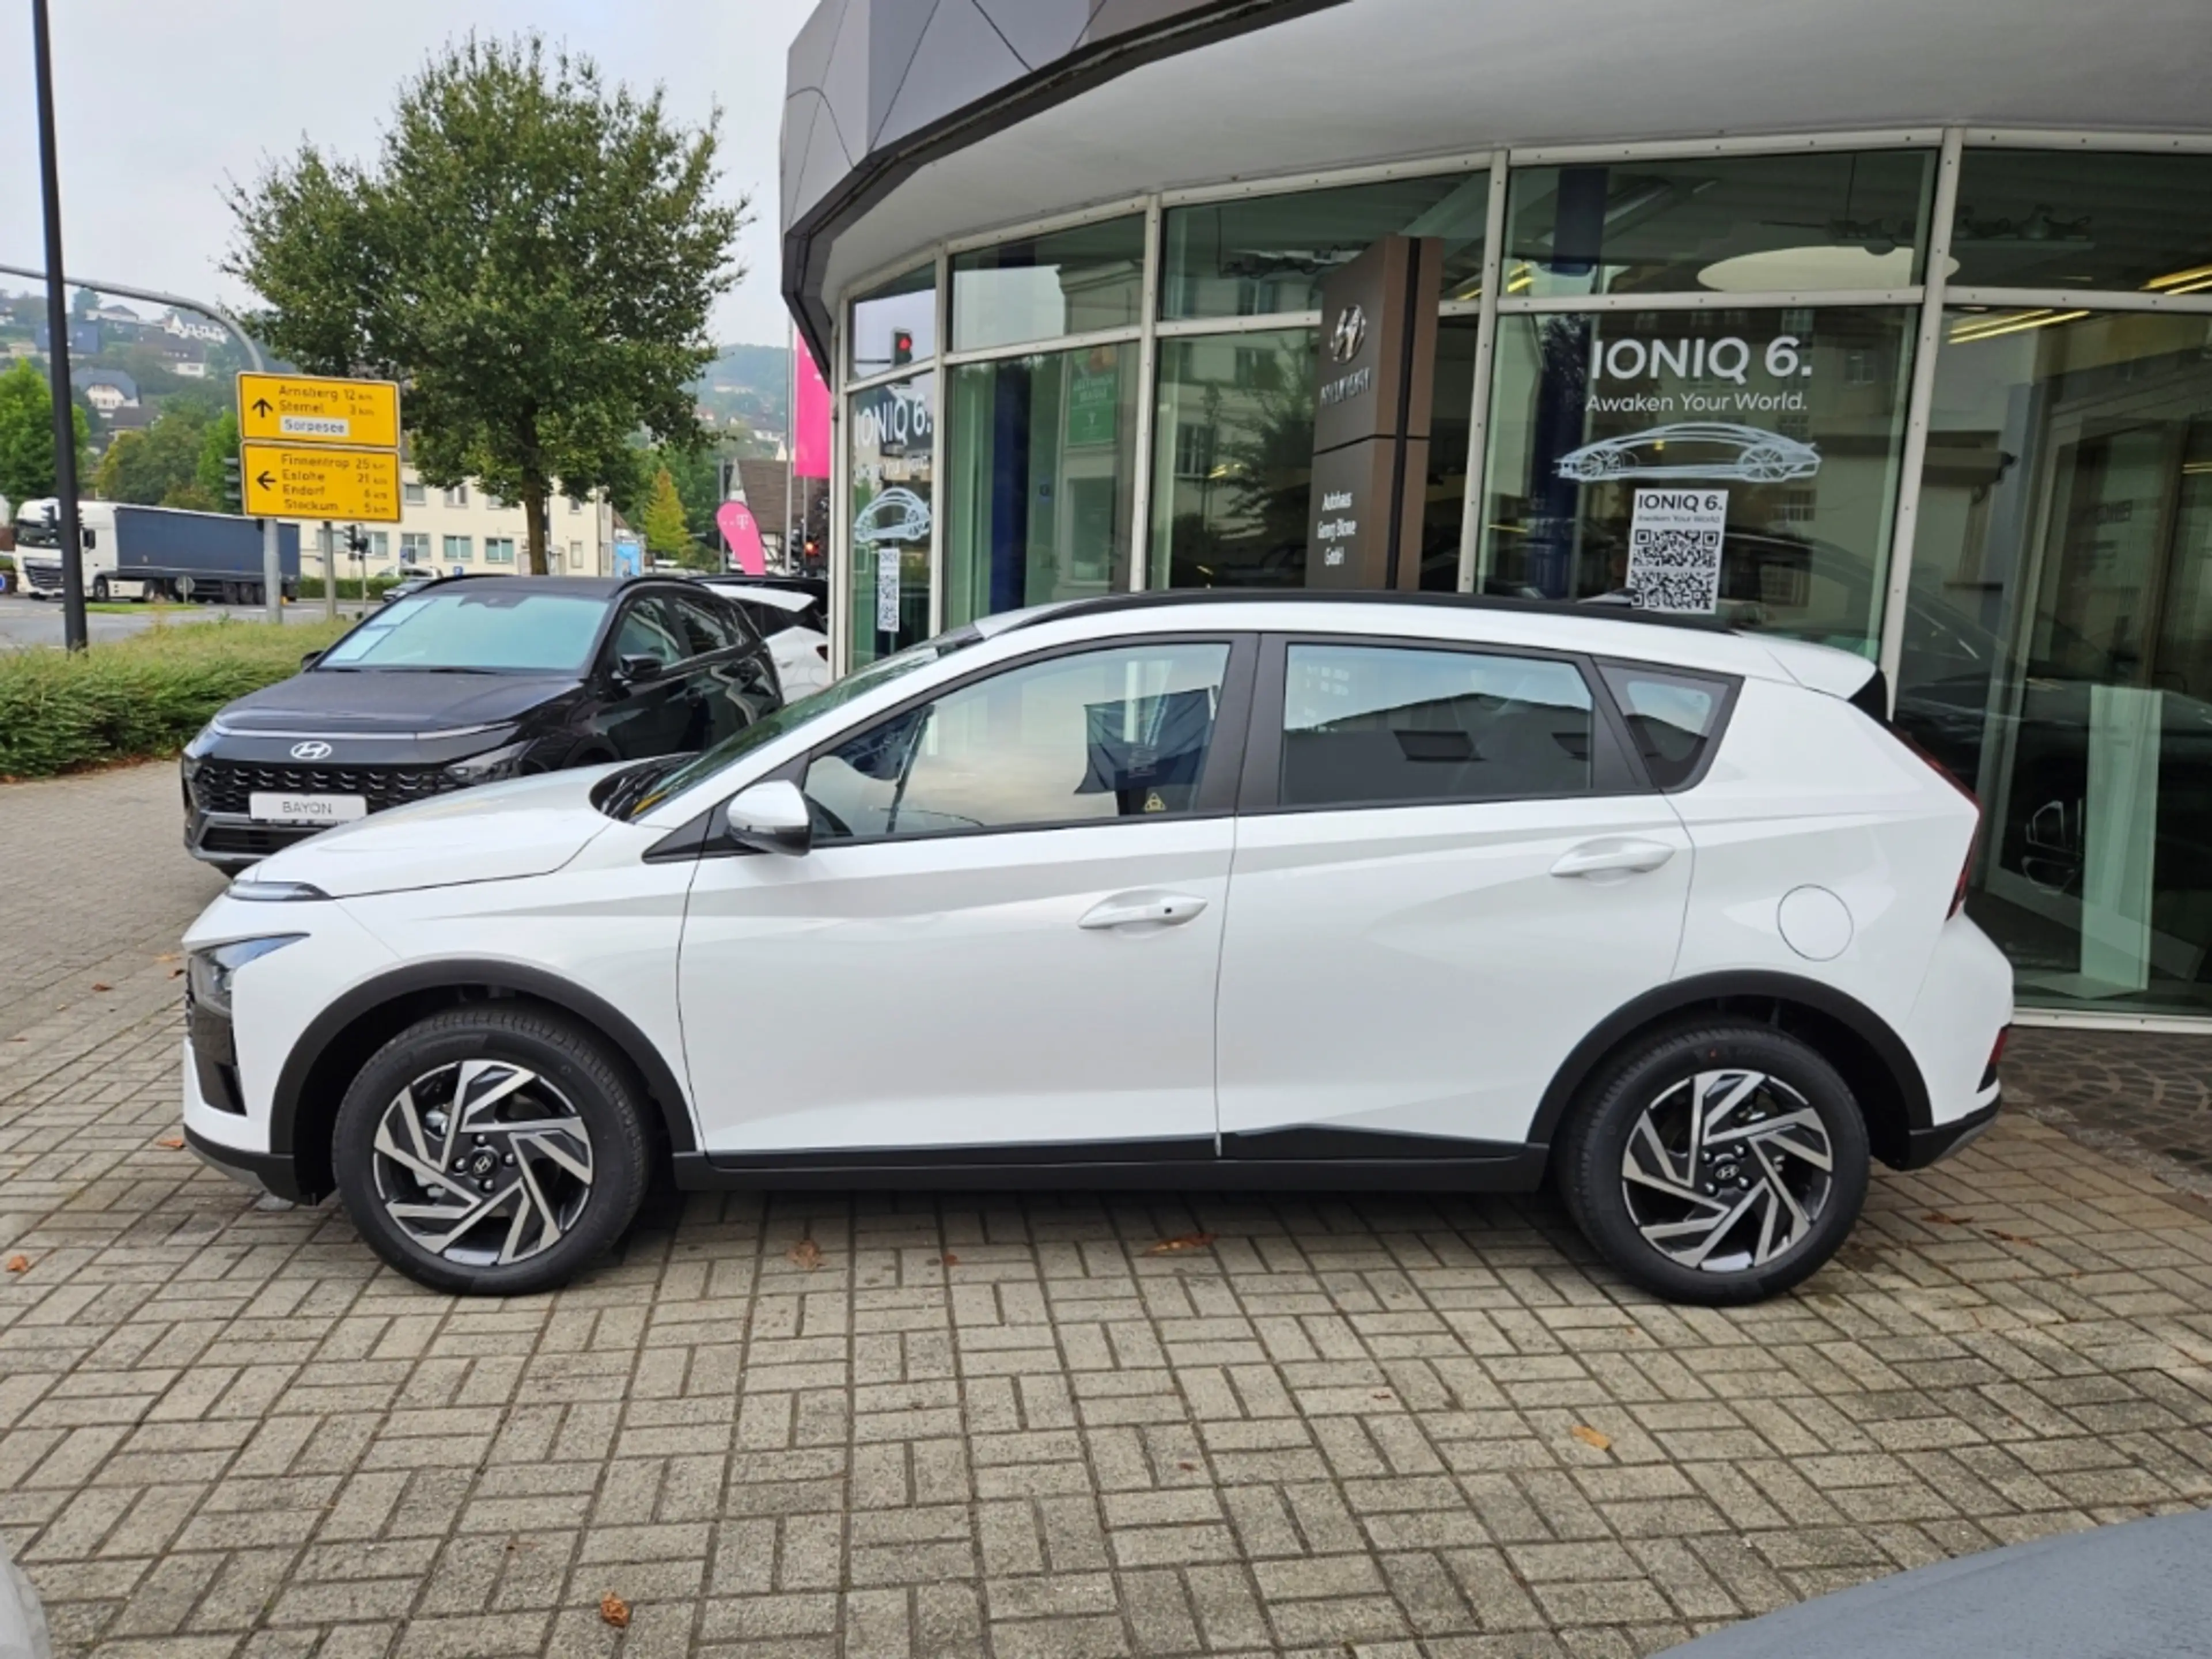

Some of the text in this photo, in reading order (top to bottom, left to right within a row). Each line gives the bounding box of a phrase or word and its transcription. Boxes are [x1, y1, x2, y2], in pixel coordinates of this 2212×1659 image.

[1592, 336, 1813, 385] IONIQ 6.
[279, 385, 338, 402] Arnsberg
[344, 389, 355, 400] 12
[1585, 391, 1807, 412] Awaken Your World.
[285, 419, 344, 433] Sorpesee
[854, 393, 932, 447] IONIQ 6.
[281, 453, 350, 470] Finnentrop
[356, 458, 370, 469] 25
[282, 468, 325, 482] Eslohe
[357, 473, 370, 483] 21
[282, 484, 325, 496] Endorf
[285, 499, 339, 512] Stockum
[1639, 494, 1723, 513] IONIQ 6.
[282, 801, 332, 815] BAYON
